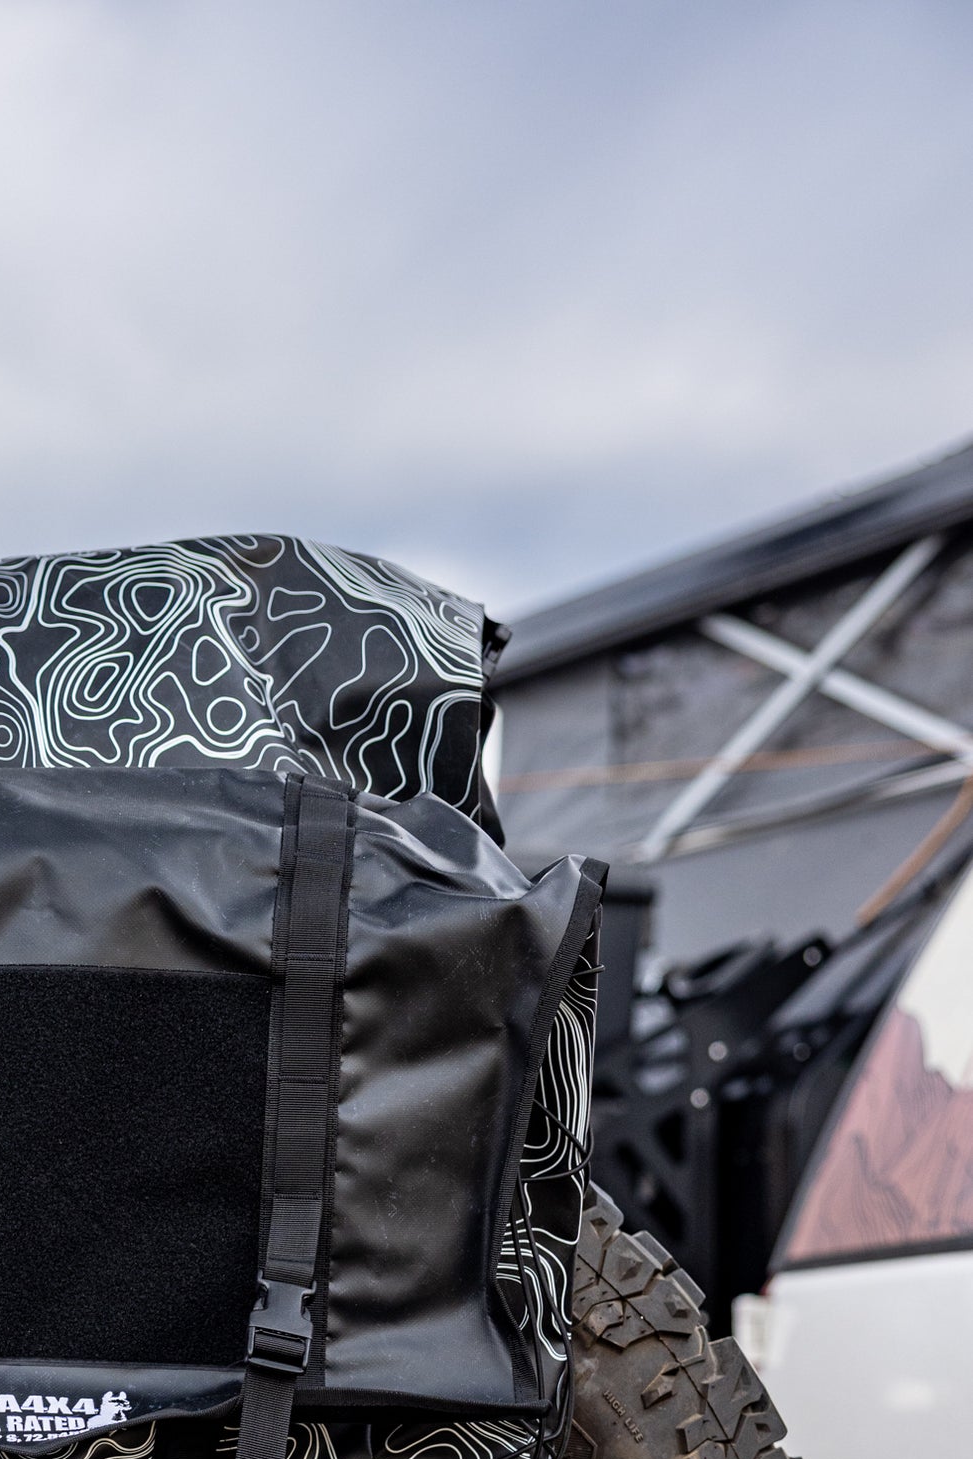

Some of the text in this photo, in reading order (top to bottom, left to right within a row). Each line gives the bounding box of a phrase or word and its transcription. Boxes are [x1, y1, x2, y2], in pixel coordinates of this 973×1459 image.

[5, 1416, 87, 1432] RATED
[603, 1389, 644, 1444] HIGH LIFE
